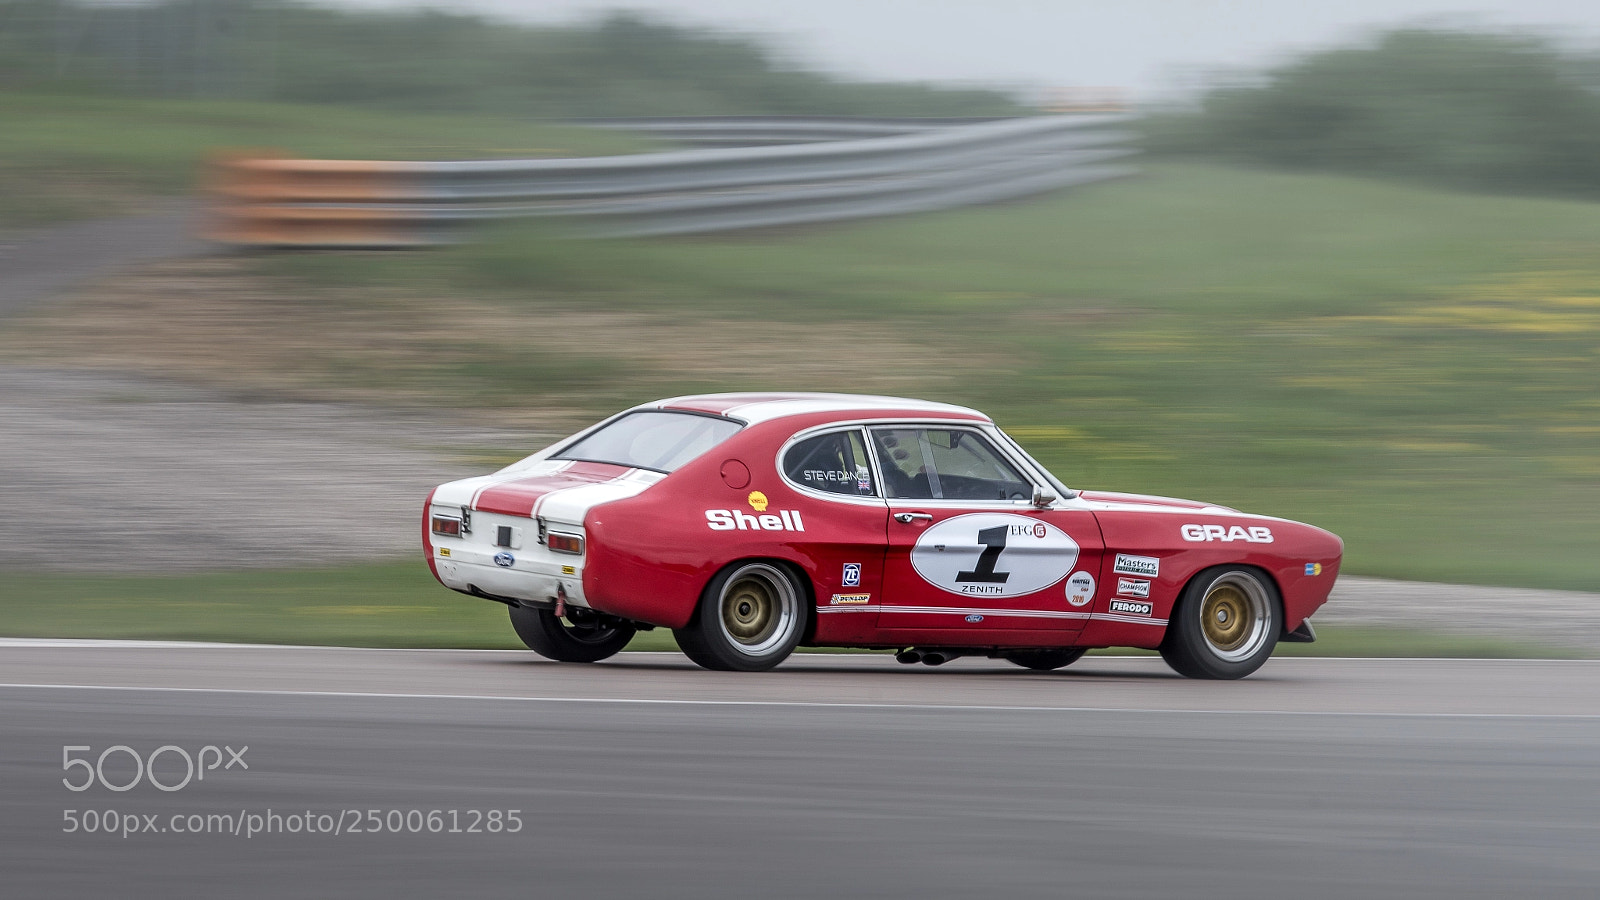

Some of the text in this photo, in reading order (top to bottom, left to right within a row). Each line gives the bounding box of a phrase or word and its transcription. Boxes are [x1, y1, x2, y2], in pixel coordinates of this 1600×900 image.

[803, 469, 837, 481] STEVE
[704, 509, 805, 532] Shell
[1011, 525, 1033, 536] EFG
[1180, 523, 1274, 544] GRAB
[955, 524, 1010, 583] 1
[1117, 557, 1157, 570] Masters
[961, 585, 1003, 594] ZENITH
[1120, 583, 1147, 592] CHAMPION
[1112, 602, 1149, 613] FERODO
